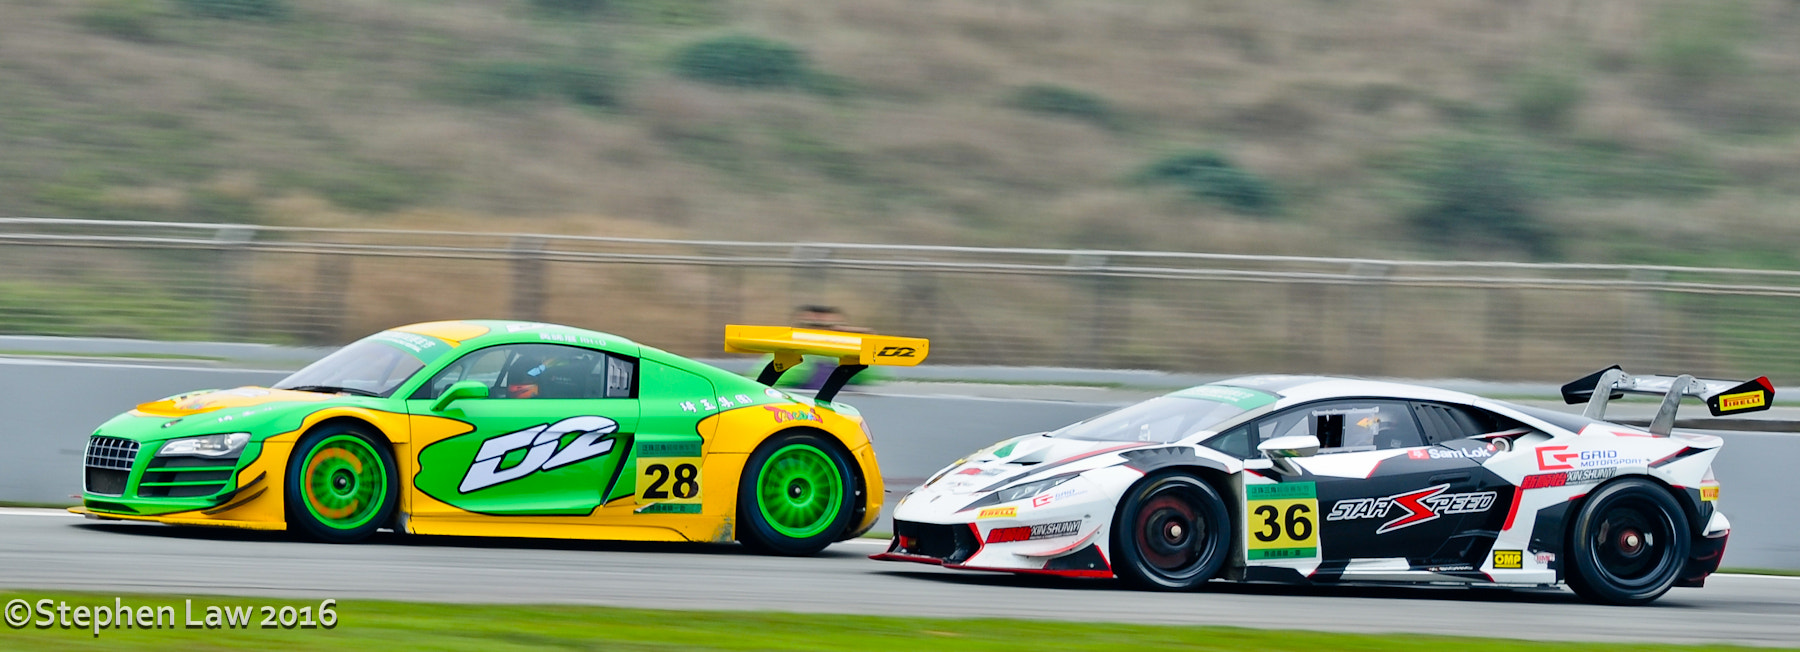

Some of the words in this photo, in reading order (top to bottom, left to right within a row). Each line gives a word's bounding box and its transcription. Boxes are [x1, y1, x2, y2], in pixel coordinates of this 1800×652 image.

[876, 346, 916, 358] D2
[1723, 394, 1760, 408] PIRELLI
[457, 415, 620, 494] D2
[1581, 450, 1617, 460] GRID
[1580, 458, 1642, 468] MOTORSPORT
[642, 463, 699, 500] 28
[979, 507, 1016, 517] PIRELLI
[1253, 503, 1313, 542] 36
[1494, 554, 1522, 566] OMP
